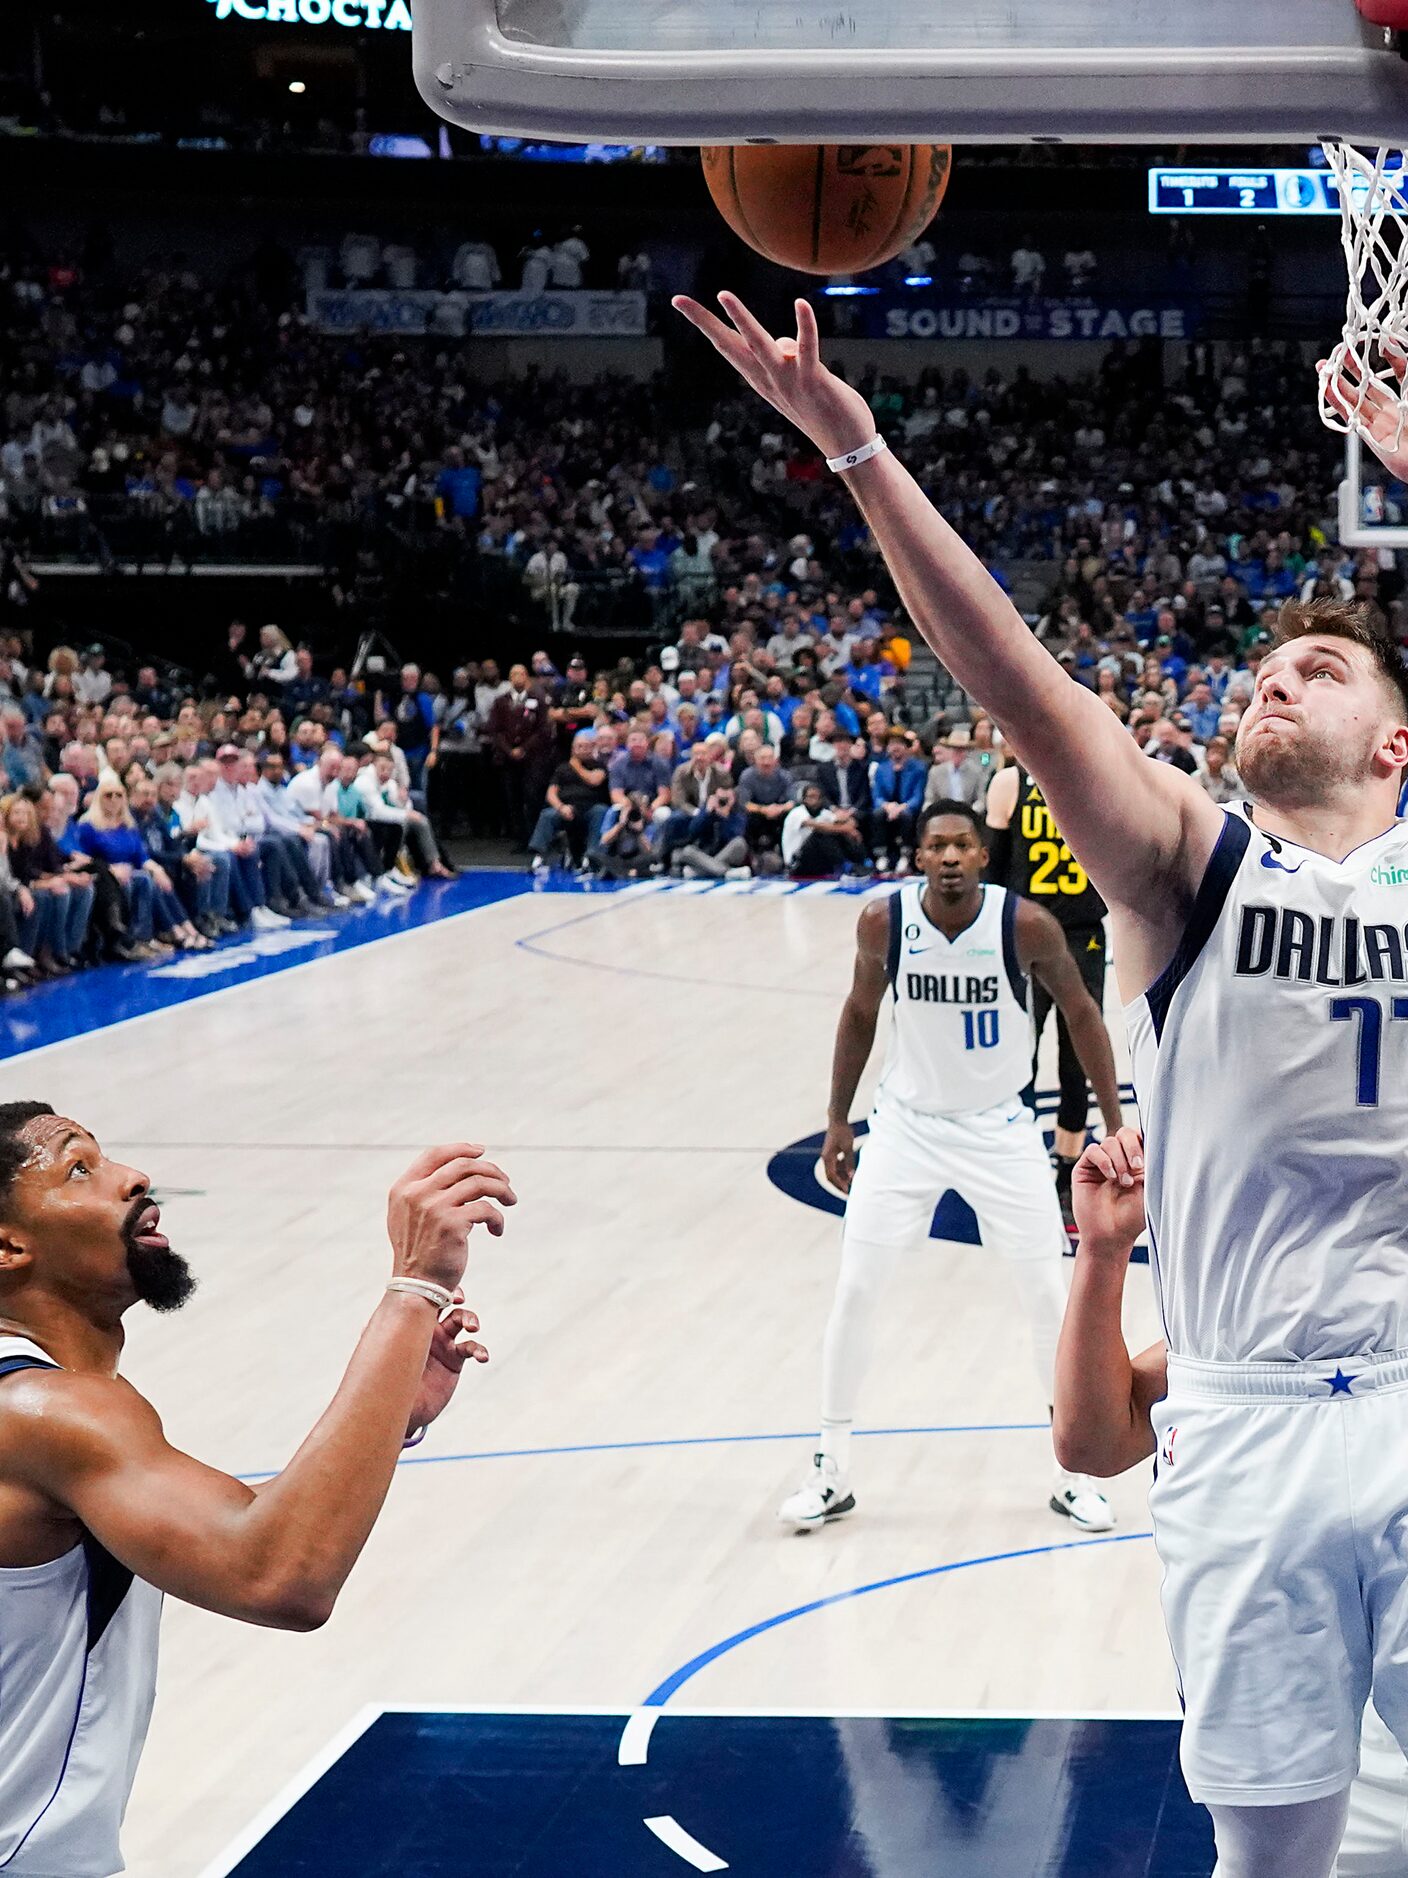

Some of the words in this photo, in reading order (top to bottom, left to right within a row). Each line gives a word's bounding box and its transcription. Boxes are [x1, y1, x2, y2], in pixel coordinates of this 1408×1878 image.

[1182, 188, 1195, 208] 1
[1239, 188, 1256, 208] 2
[886, 308, 1021, 337] SOUND
[1050, 309, 1185, 337] STAGE
[1028, 841, 1088, 895] 23
[906, 972, 998, 1004] DALLAS
[961, 1009, 999, 1051] 10
